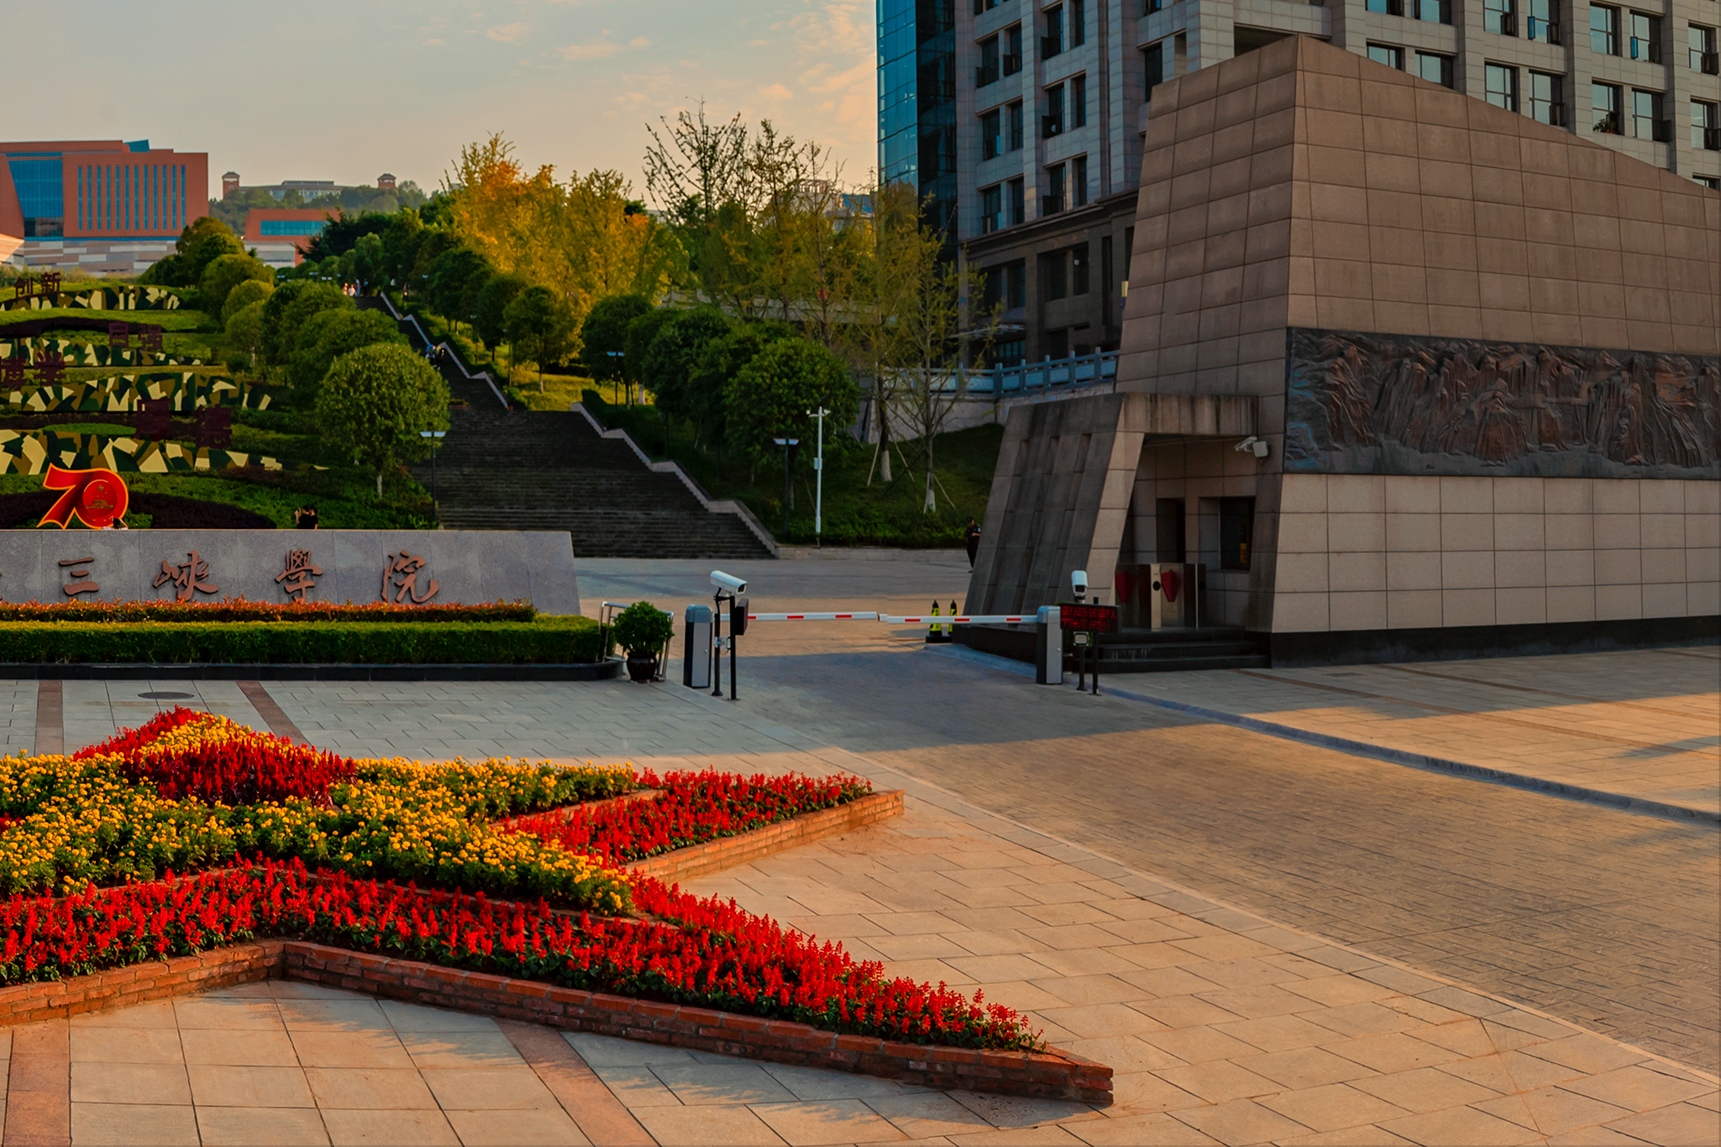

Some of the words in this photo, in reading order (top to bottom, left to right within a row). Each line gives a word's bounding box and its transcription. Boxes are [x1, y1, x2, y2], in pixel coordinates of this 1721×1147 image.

[14, 272, 62, 299] 创新
[108, 320, 164, 351] 自强
[36, 462, 129, 530] 70
